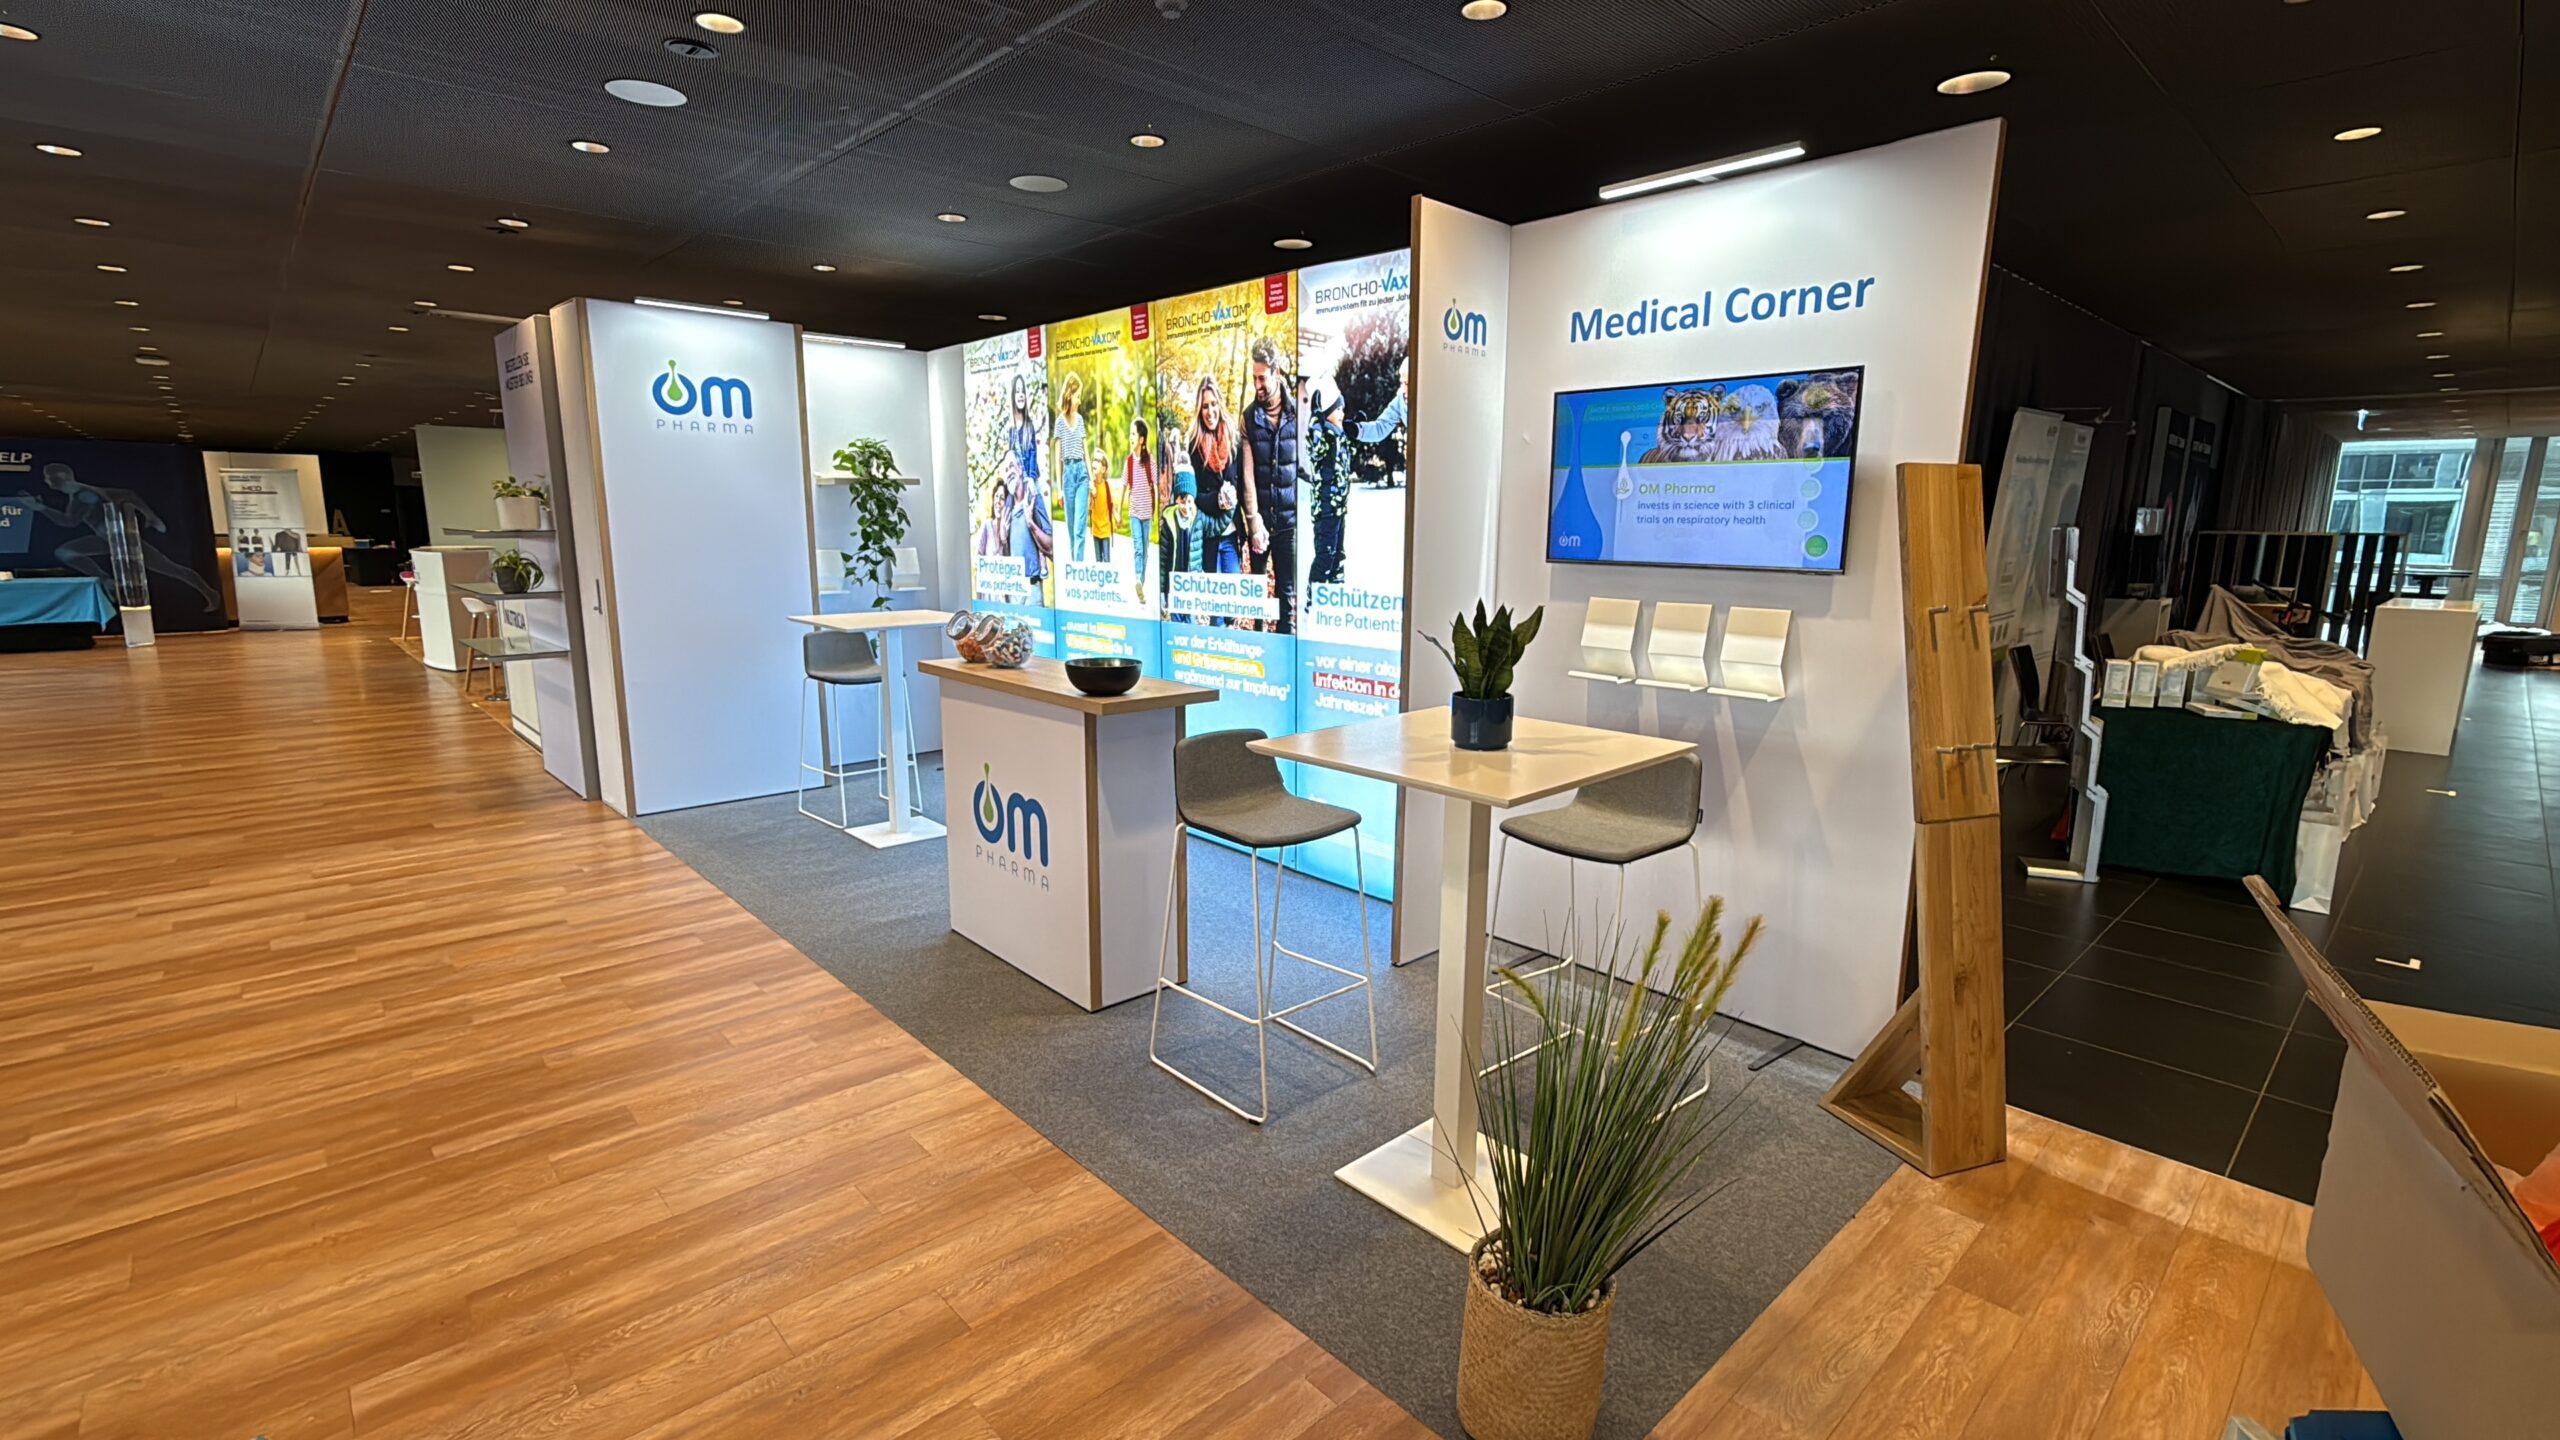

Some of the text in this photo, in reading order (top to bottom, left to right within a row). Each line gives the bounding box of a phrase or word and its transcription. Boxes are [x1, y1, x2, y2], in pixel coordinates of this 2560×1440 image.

[1570, 276, 1876, 343] Medical Corner
[656, 419, 754, 435] PHARMA
[1638, 483, 1716, 494] OM Pharma
[1637, 499, 1795, 511] invests in science with 3 clinical
[1637, 515, 1766, 527] trials on respiratory health
[978, 557, 1023, 579] Protégez
[1065, 563, 1120, 588] Protégez
[1065, 588, 1082, 600] vos
[1173, 574, 1263, 598] Schützen Sie
[1173, 596, 1193, 609] Ihre
[1316, 611, 1342, 627] Ihre
[1339, 656, 1373, 674] einer
[1314, 673, 1372, 695] Infektion
[1373, 680, 1386, 697] in
[975, 844, 1050, 893] PHARMA
